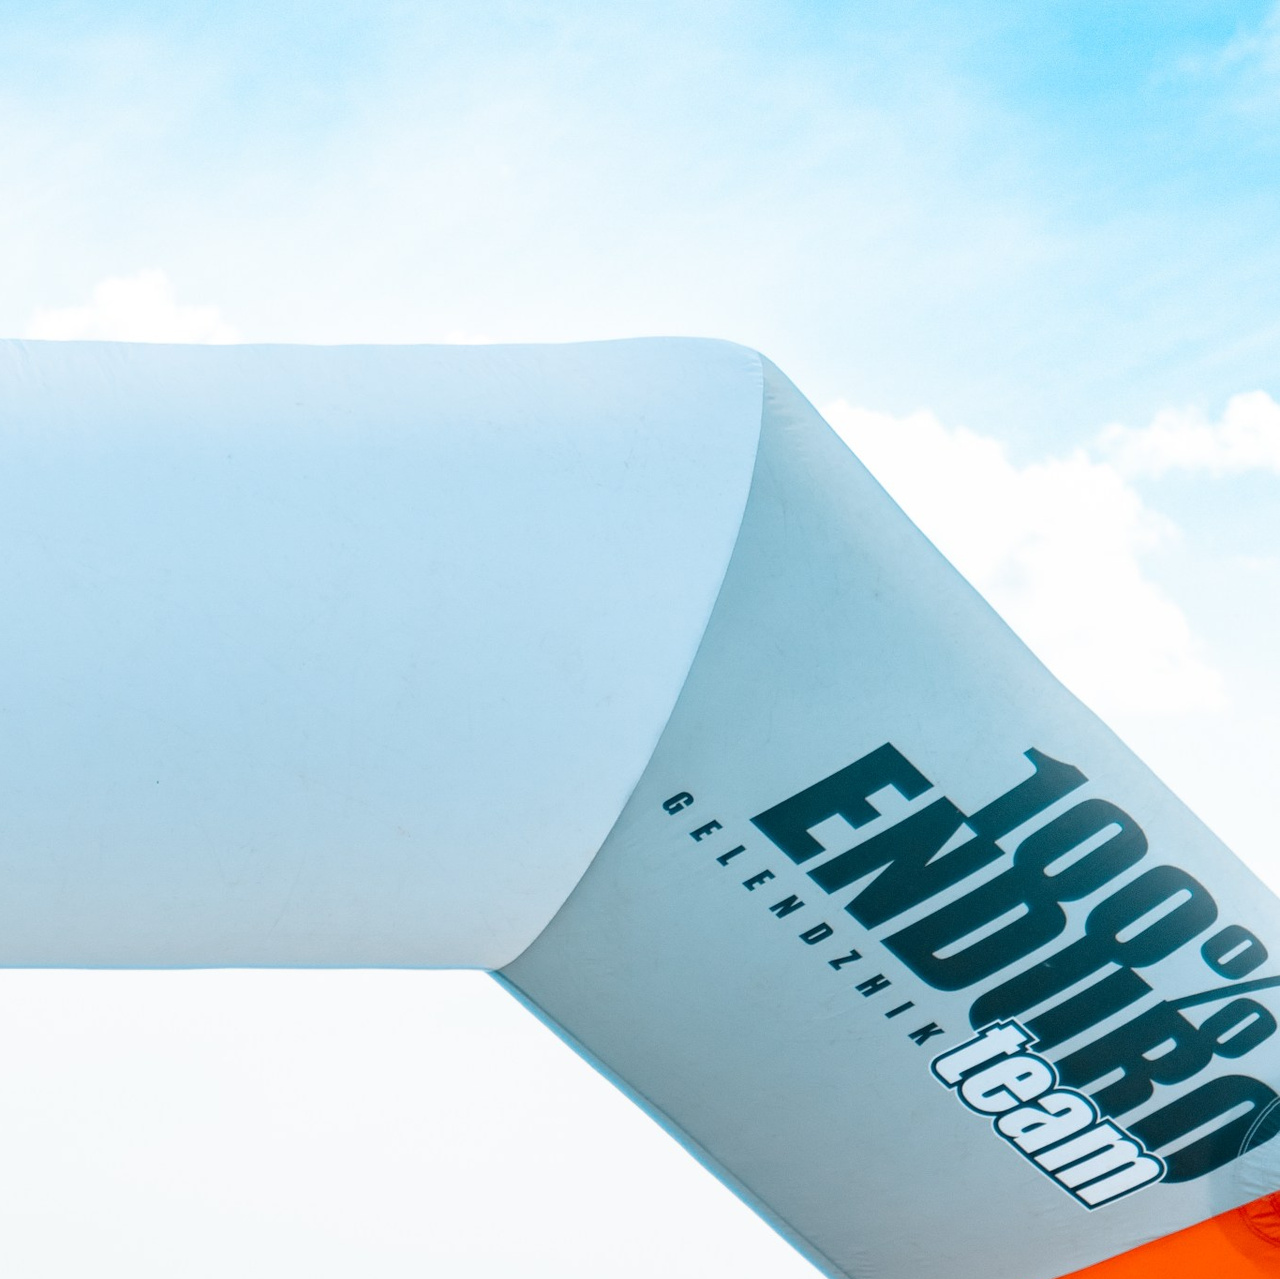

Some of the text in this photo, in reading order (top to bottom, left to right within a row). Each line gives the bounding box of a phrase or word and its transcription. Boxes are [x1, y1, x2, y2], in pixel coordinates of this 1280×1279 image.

[662, 791, 946, 1046] GELENDZHIK
[749, 742, 1280, 1184] ENDURO
[968, 746, 1280, 1060] 100%
[929, 1017, 1167, 1211] team
